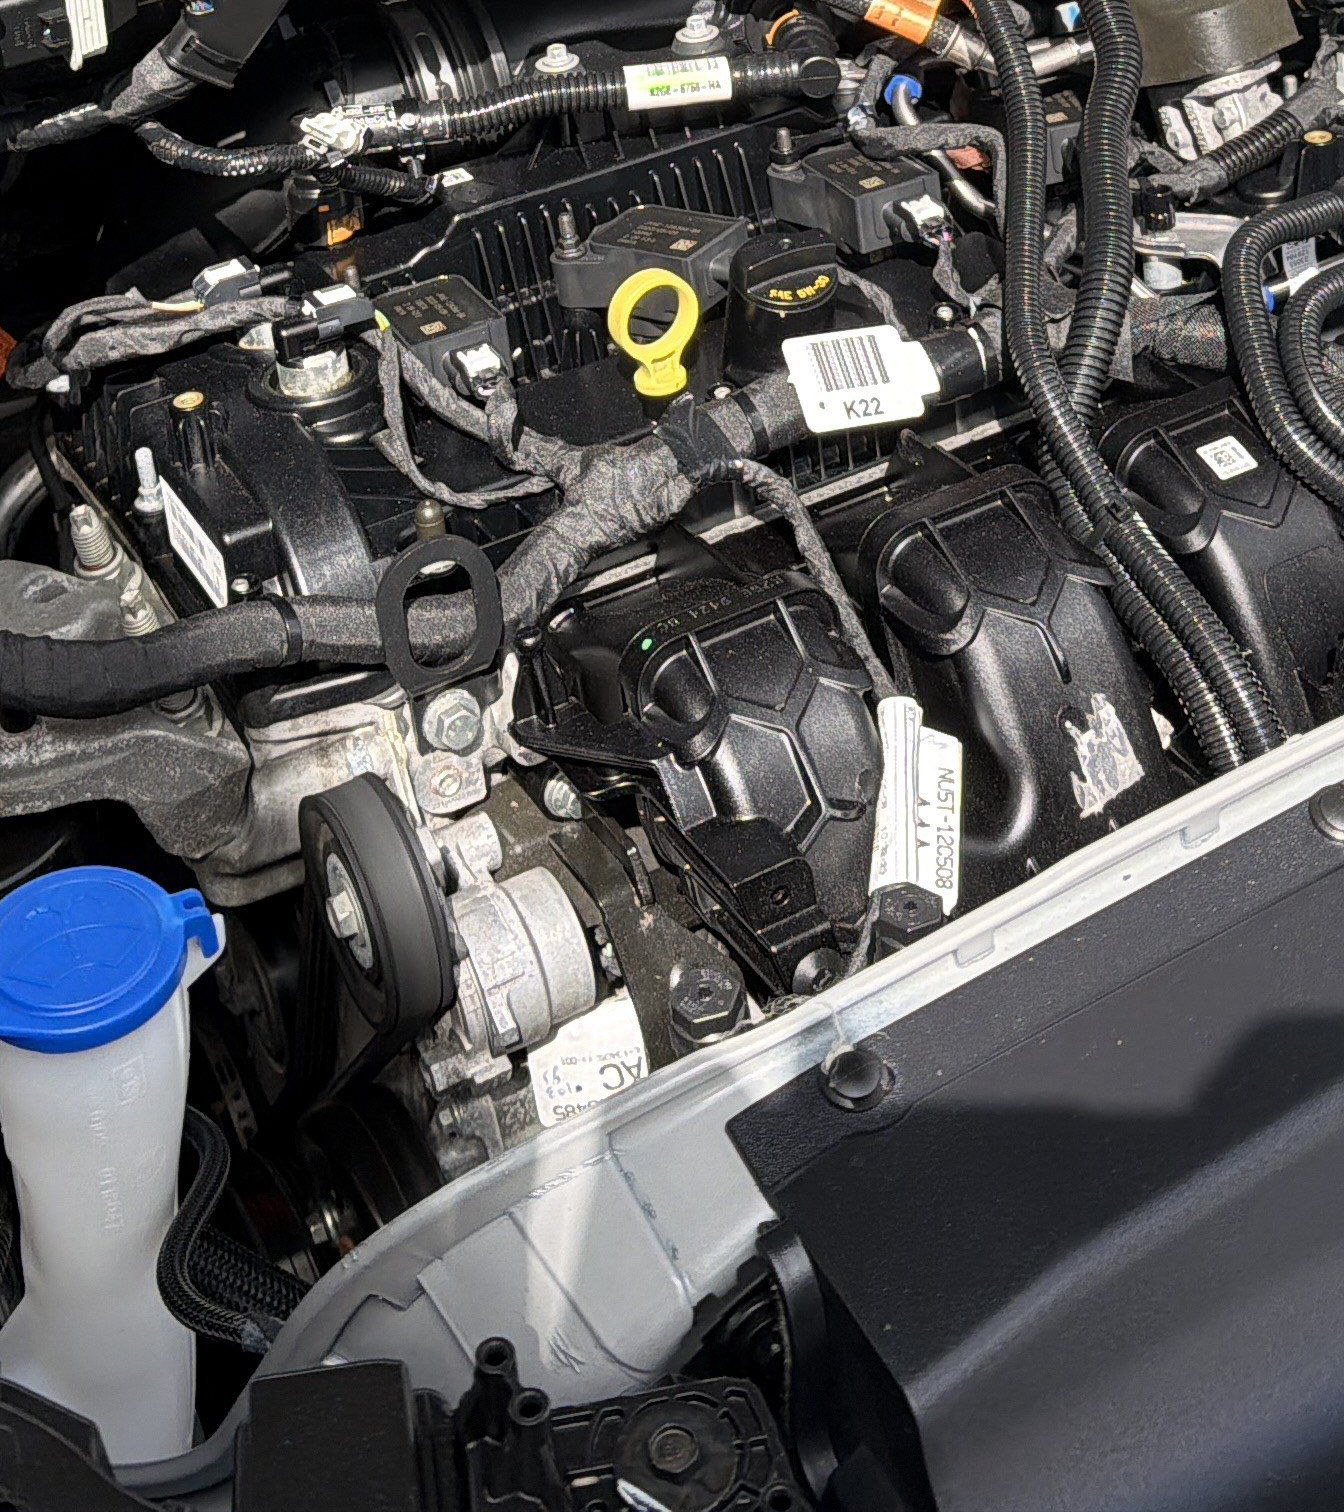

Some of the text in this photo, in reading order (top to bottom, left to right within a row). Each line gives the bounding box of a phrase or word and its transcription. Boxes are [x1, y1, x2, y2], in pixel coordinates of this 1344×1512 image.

[843, 397, 884, 419] K22
[935, 767, 955, 889] NU5T-12C508
[599, 1056, 642, 1090] AC
